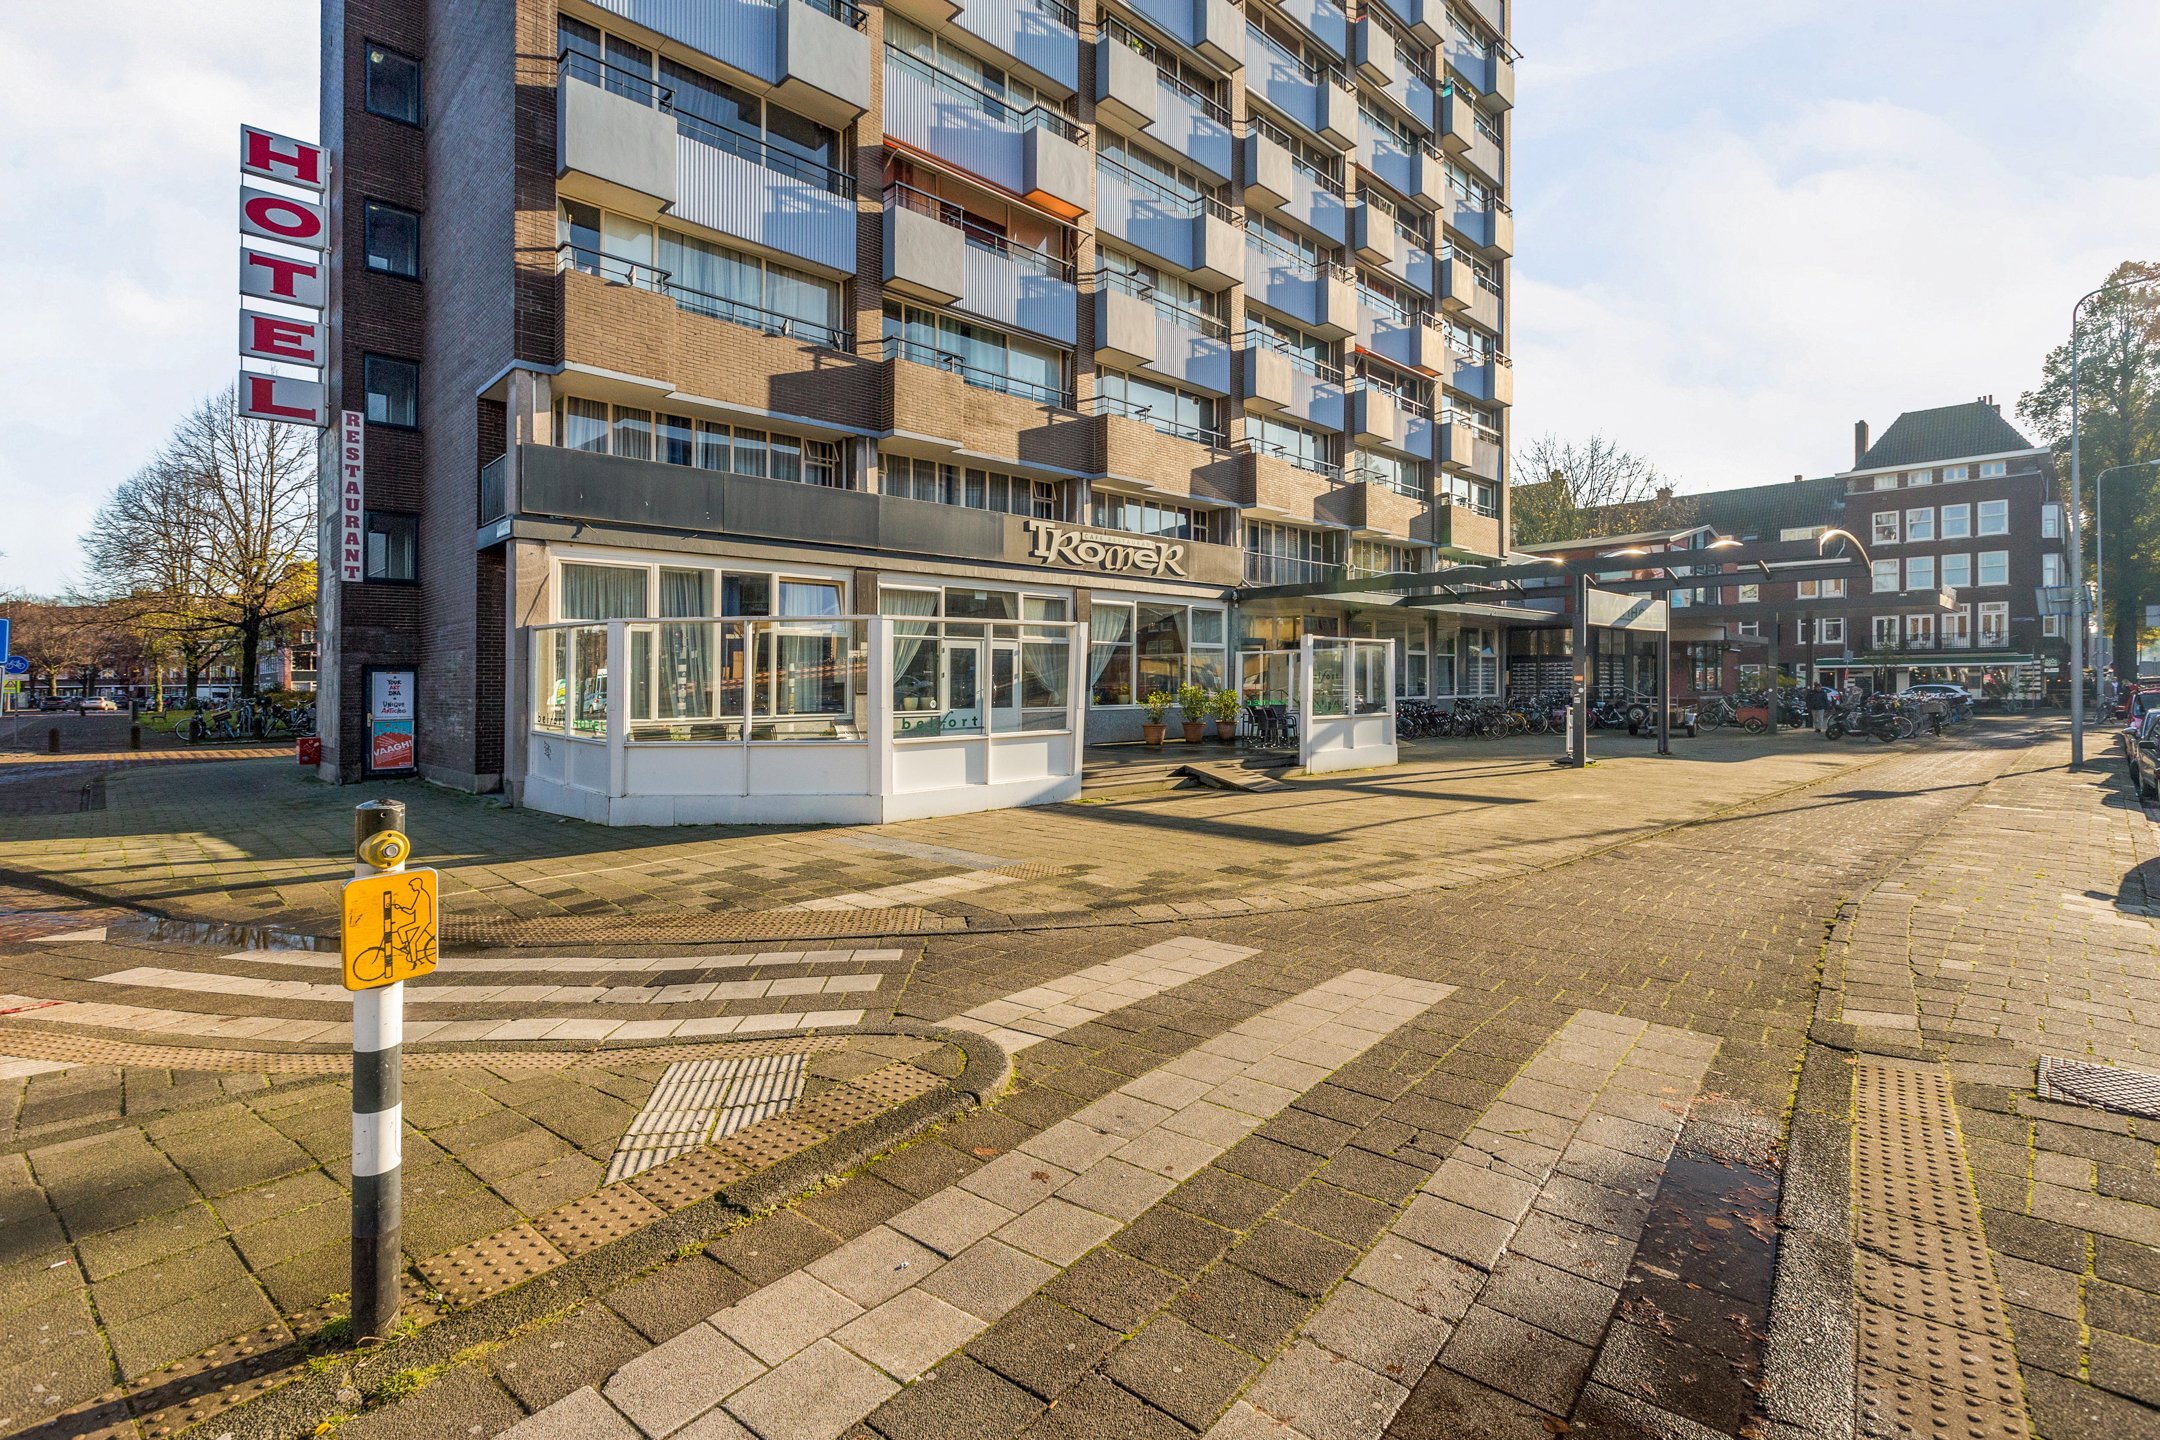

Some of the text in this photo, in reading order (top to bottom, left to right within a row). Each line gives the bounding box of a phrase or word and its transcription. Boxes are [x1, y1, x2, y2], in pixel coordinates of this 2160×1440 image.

[245, 130, 322, 422] HOTEL
[345, 412, 360, 579] RESTAURANT
[573, 719, 606, 731] HOTEL
[901, 710, 978, 730] belfort
